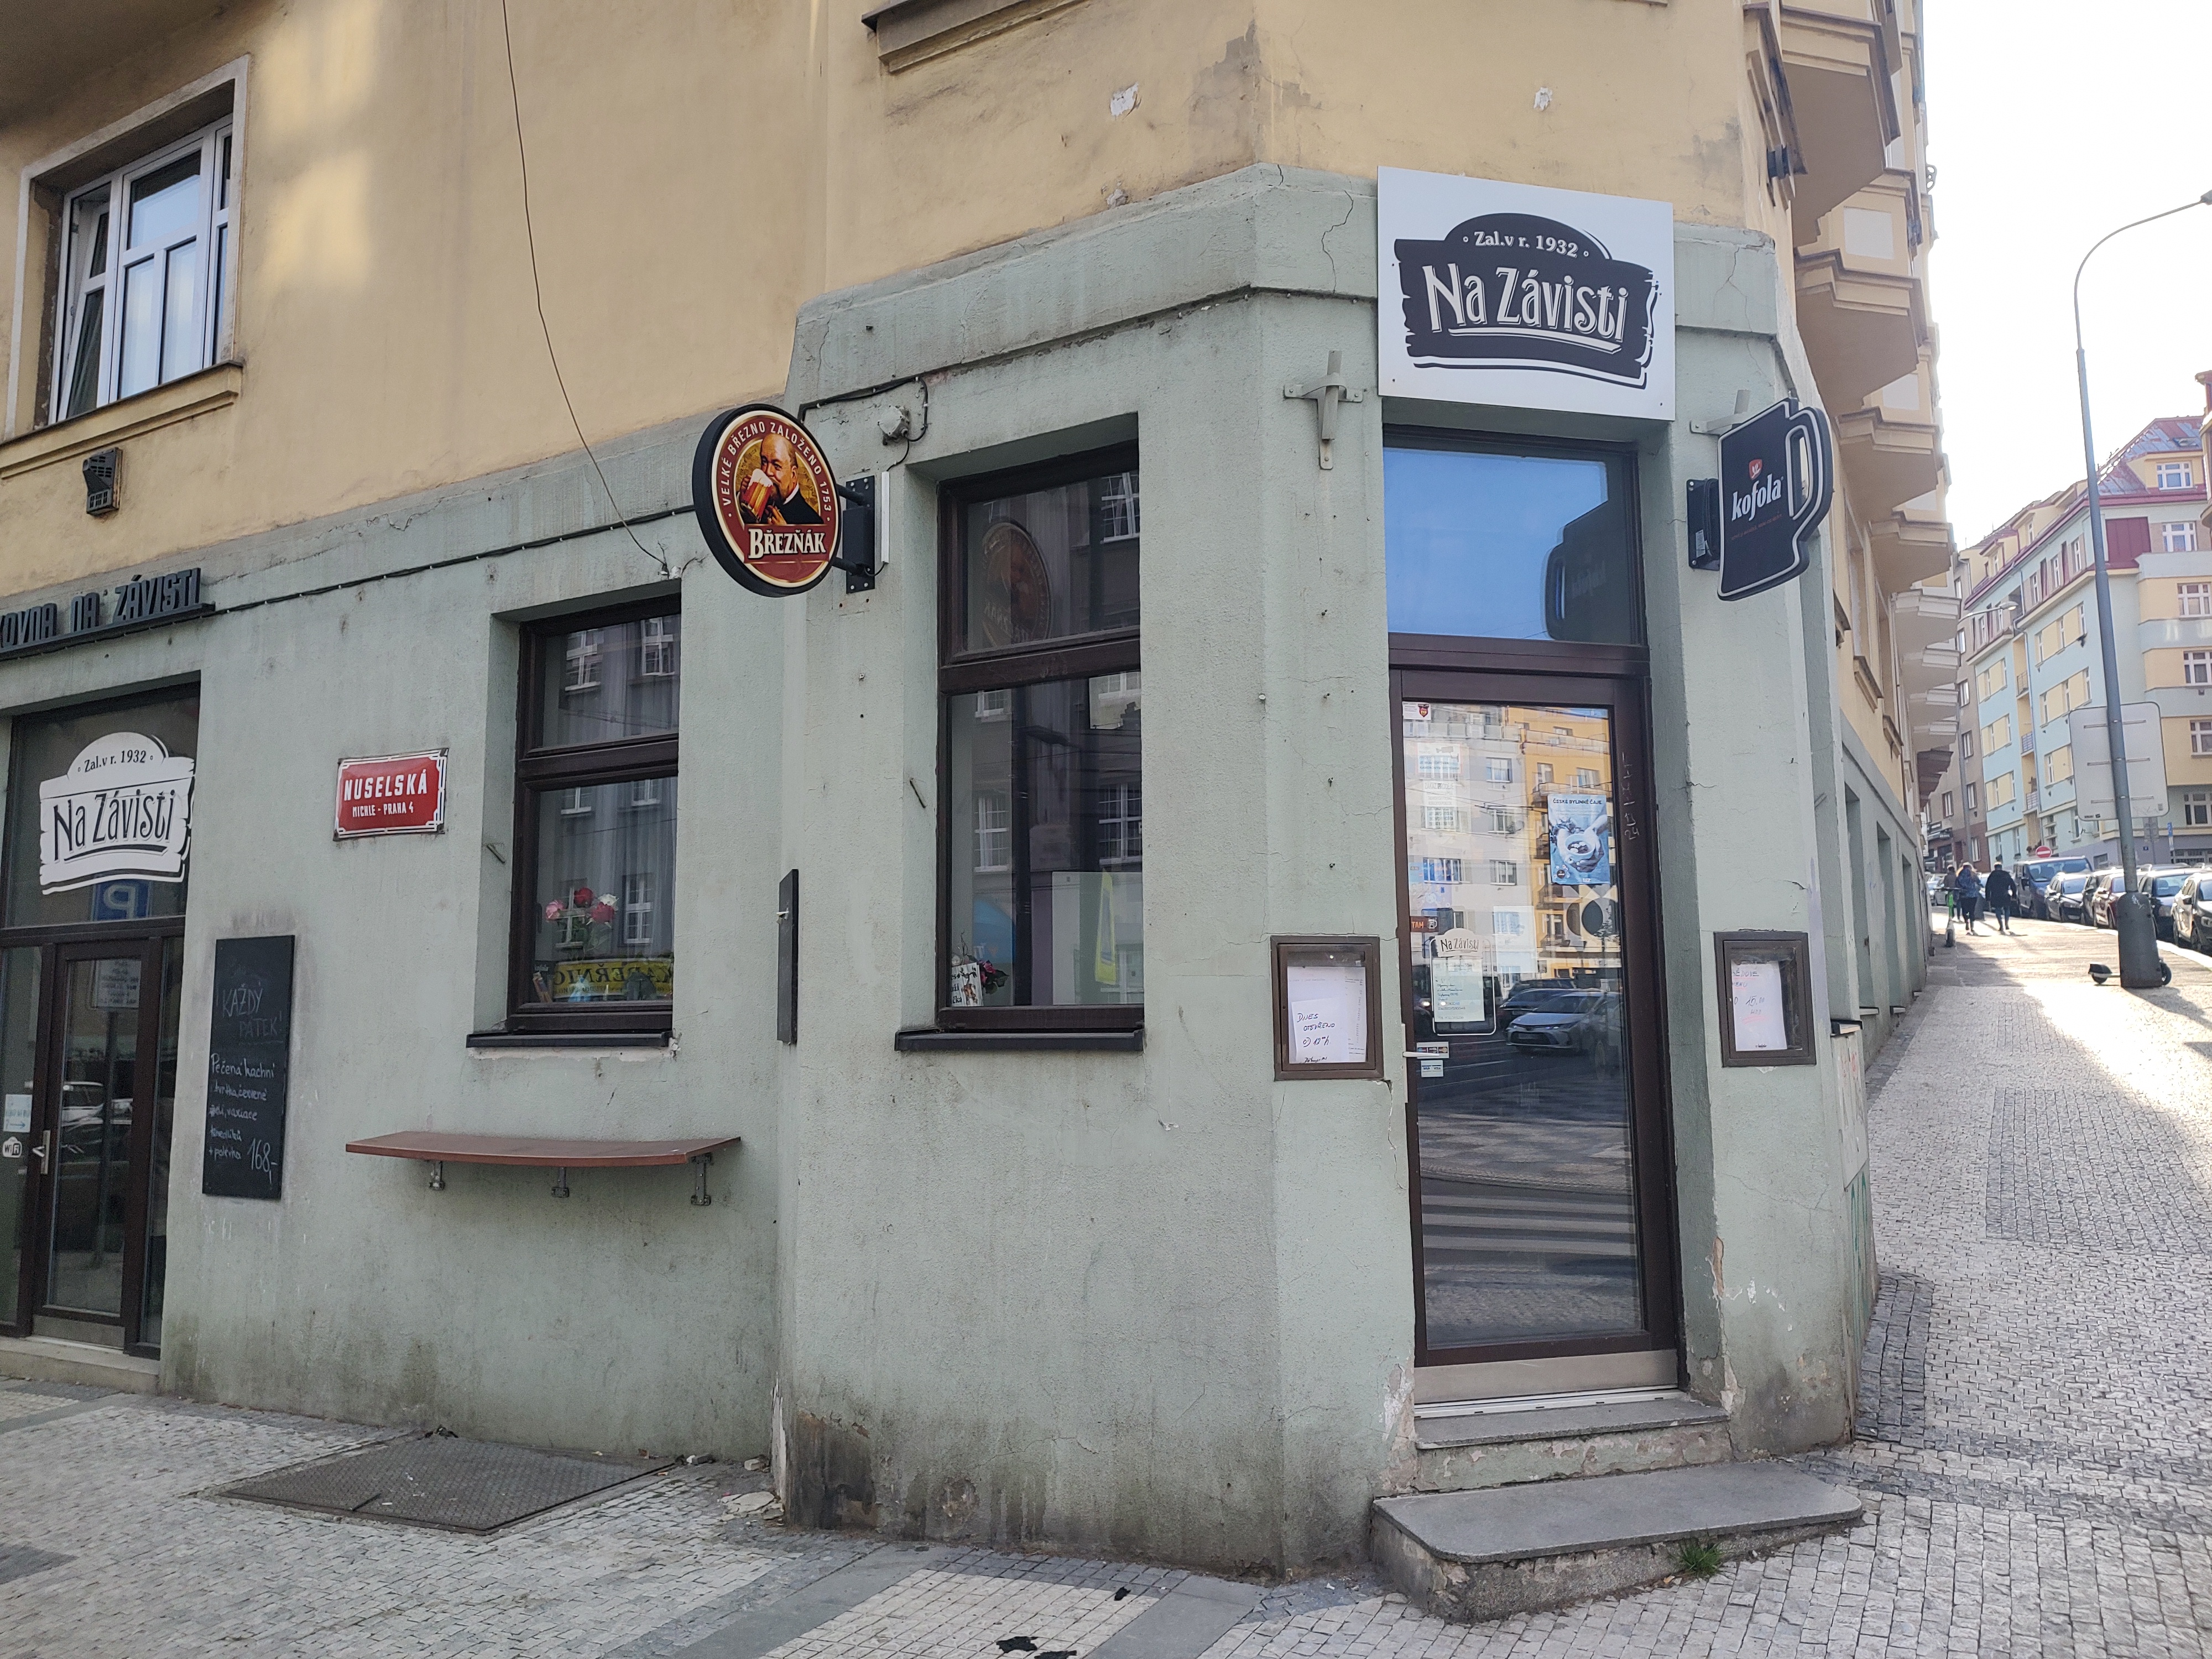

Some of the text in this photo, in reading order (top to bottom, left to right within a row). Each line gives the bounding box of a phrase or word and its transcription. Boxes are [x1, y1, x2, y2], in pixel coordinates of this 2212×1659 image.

[1519, 236, 1529, 248] r.
[1536, 235, 1578, 258] 1932
[1422, 263, 1629, 342] Na Závisti
[721, 421, 832, 512] VELKÉ BŘEZNO ZALOŽENO 1753
[1731, 473, 1782, 521] kofola
[748, 528, 826, 559] BŘEZŇÁK
[0, 603, 57, 649] OVNA
[113, 567, 201, 624] ZÁVISTI
[121, 750, 147, 763] 1932
[344, 769, 427, 801] NUSELSKÁ
[352, 805, 376, 818] MICHLE
[383, 802, 406, 815] PRAHA
[409, 801, 414, 813] 4
[54, 789, 176, 862] Na Závisti
[1441, 938, 1453, 952] Na
[1297, 1013, 1318, 1023] DNES
